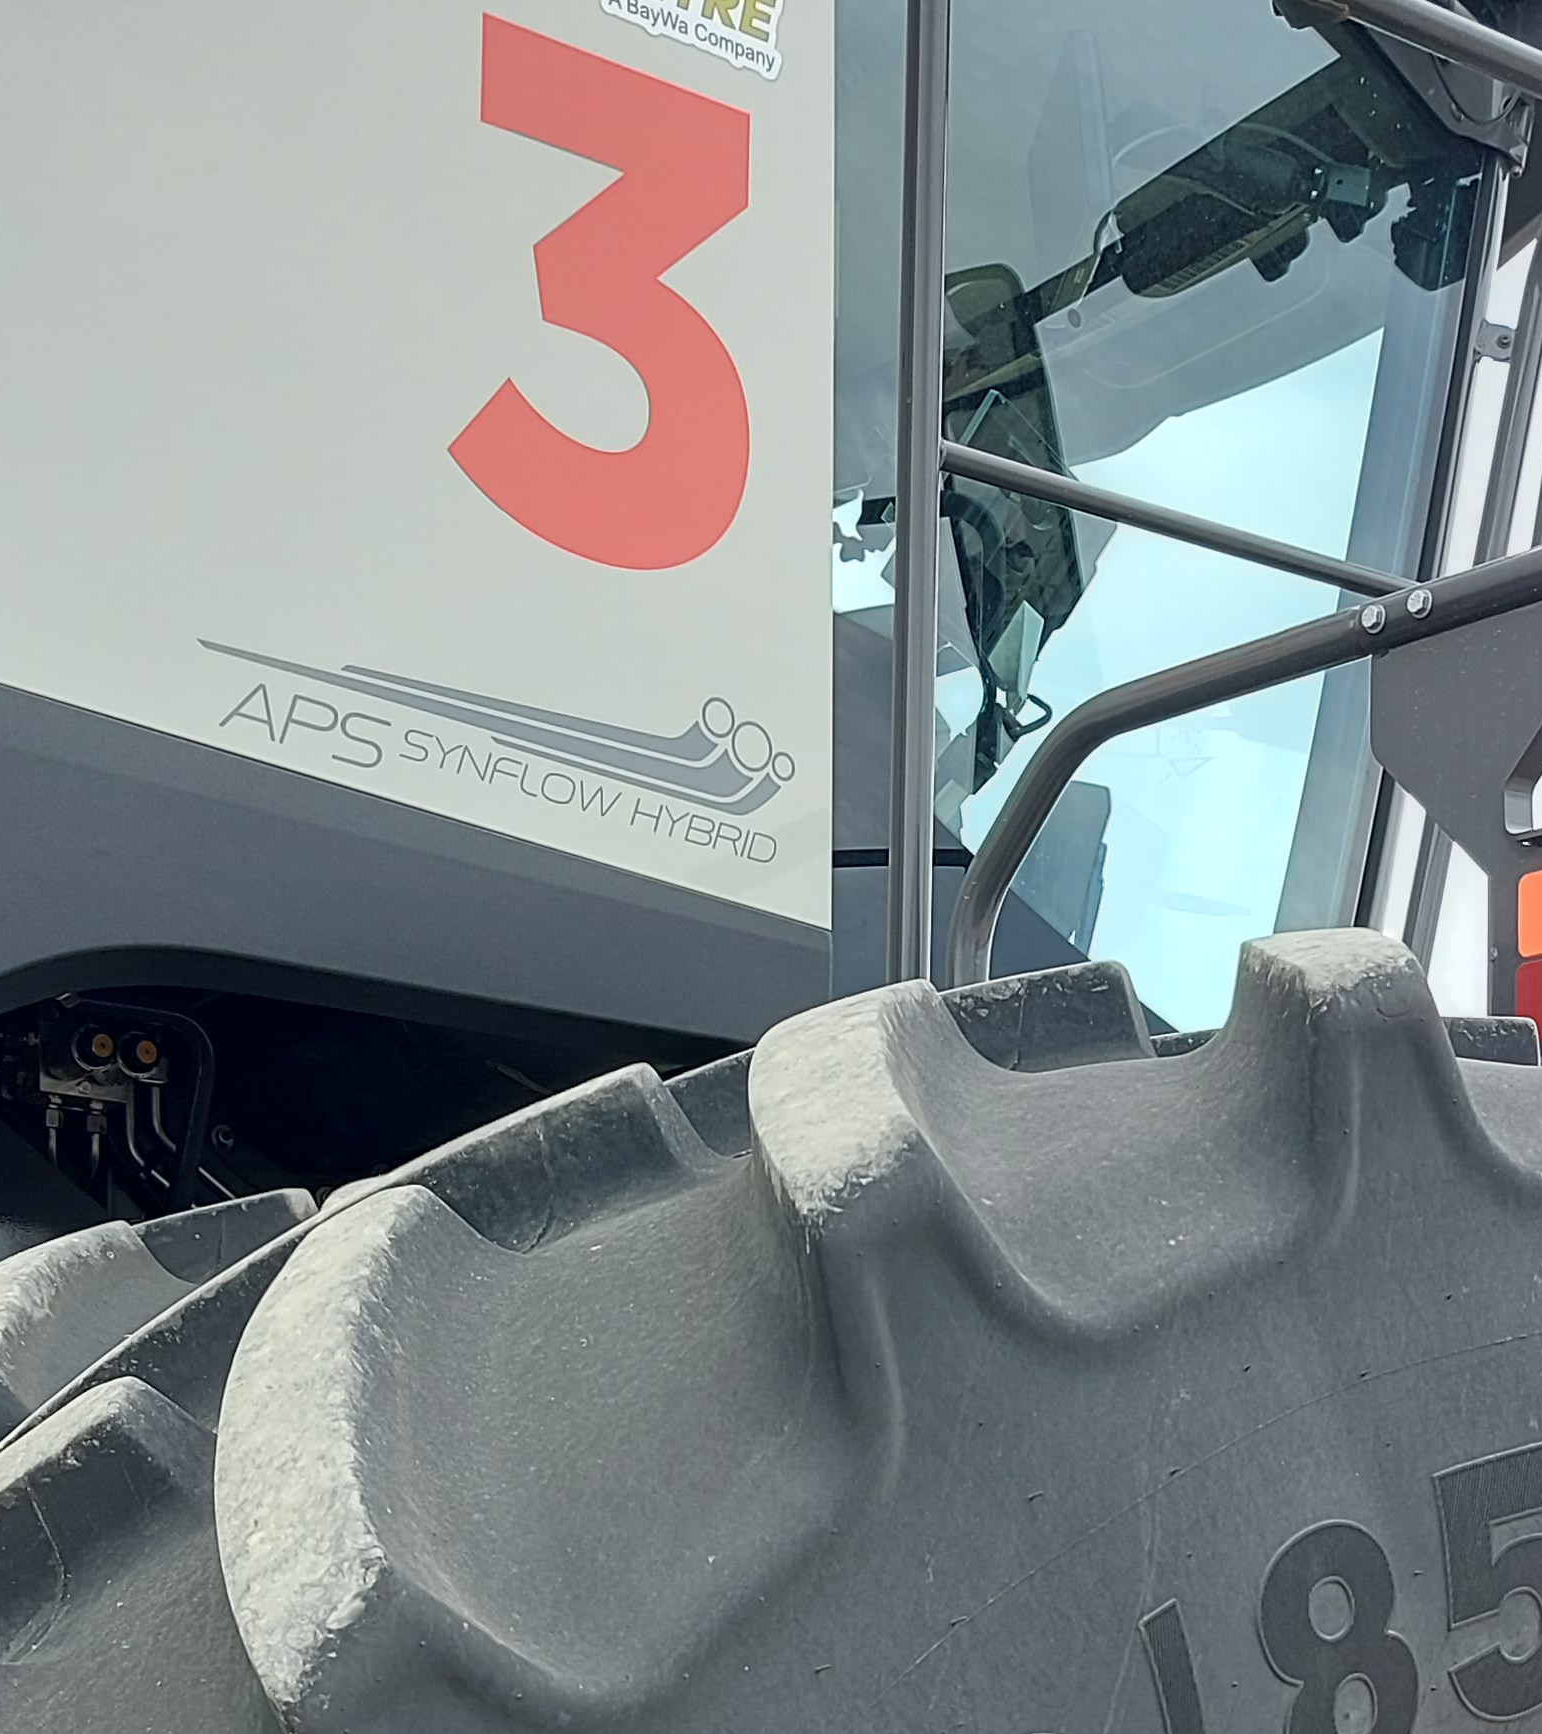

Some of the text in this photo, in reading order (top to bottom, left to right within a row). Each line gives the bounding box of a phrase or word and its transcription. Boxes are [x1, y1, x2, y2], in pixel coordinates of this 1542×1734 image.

[626, 0, 688, 35] BayWa
[694, 23, 775, 72] Company
[448, 11, 751, 571] 3
[219, 683, 777, 864] APS SYNFLOW HYBRID
